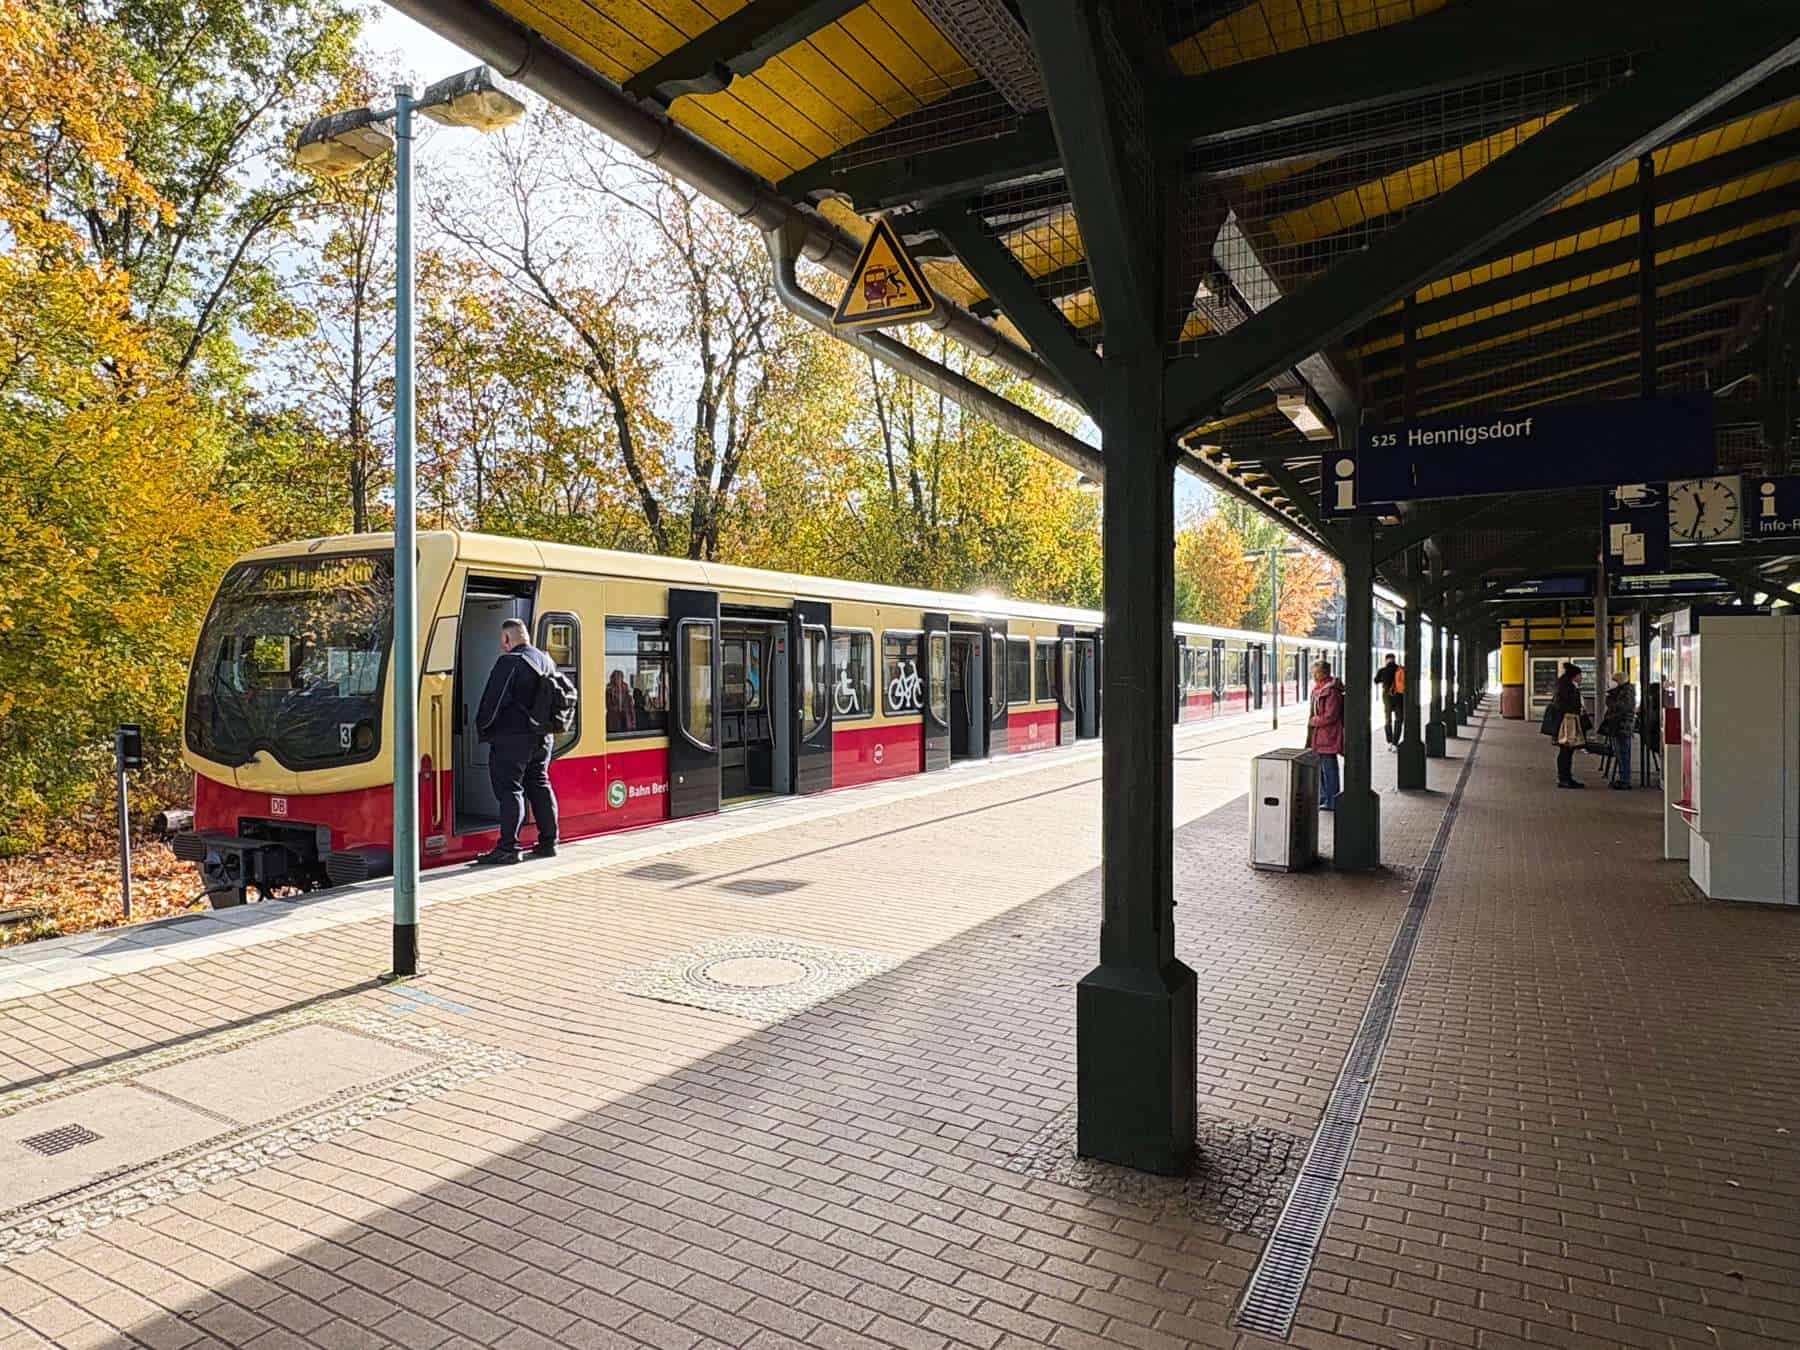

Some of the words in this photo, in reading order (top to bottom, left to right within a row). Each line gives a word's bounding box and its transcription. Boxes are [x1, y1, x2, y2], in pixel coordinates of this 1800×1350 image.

[1371, 433, 1397, 448] S25
[1408, 417, 1533, 446] Hennigsdorf
[342, 726, 350, 744] 3
[629, 785, 650, 798] Bahn
[272, 799, 286, 813] DB
